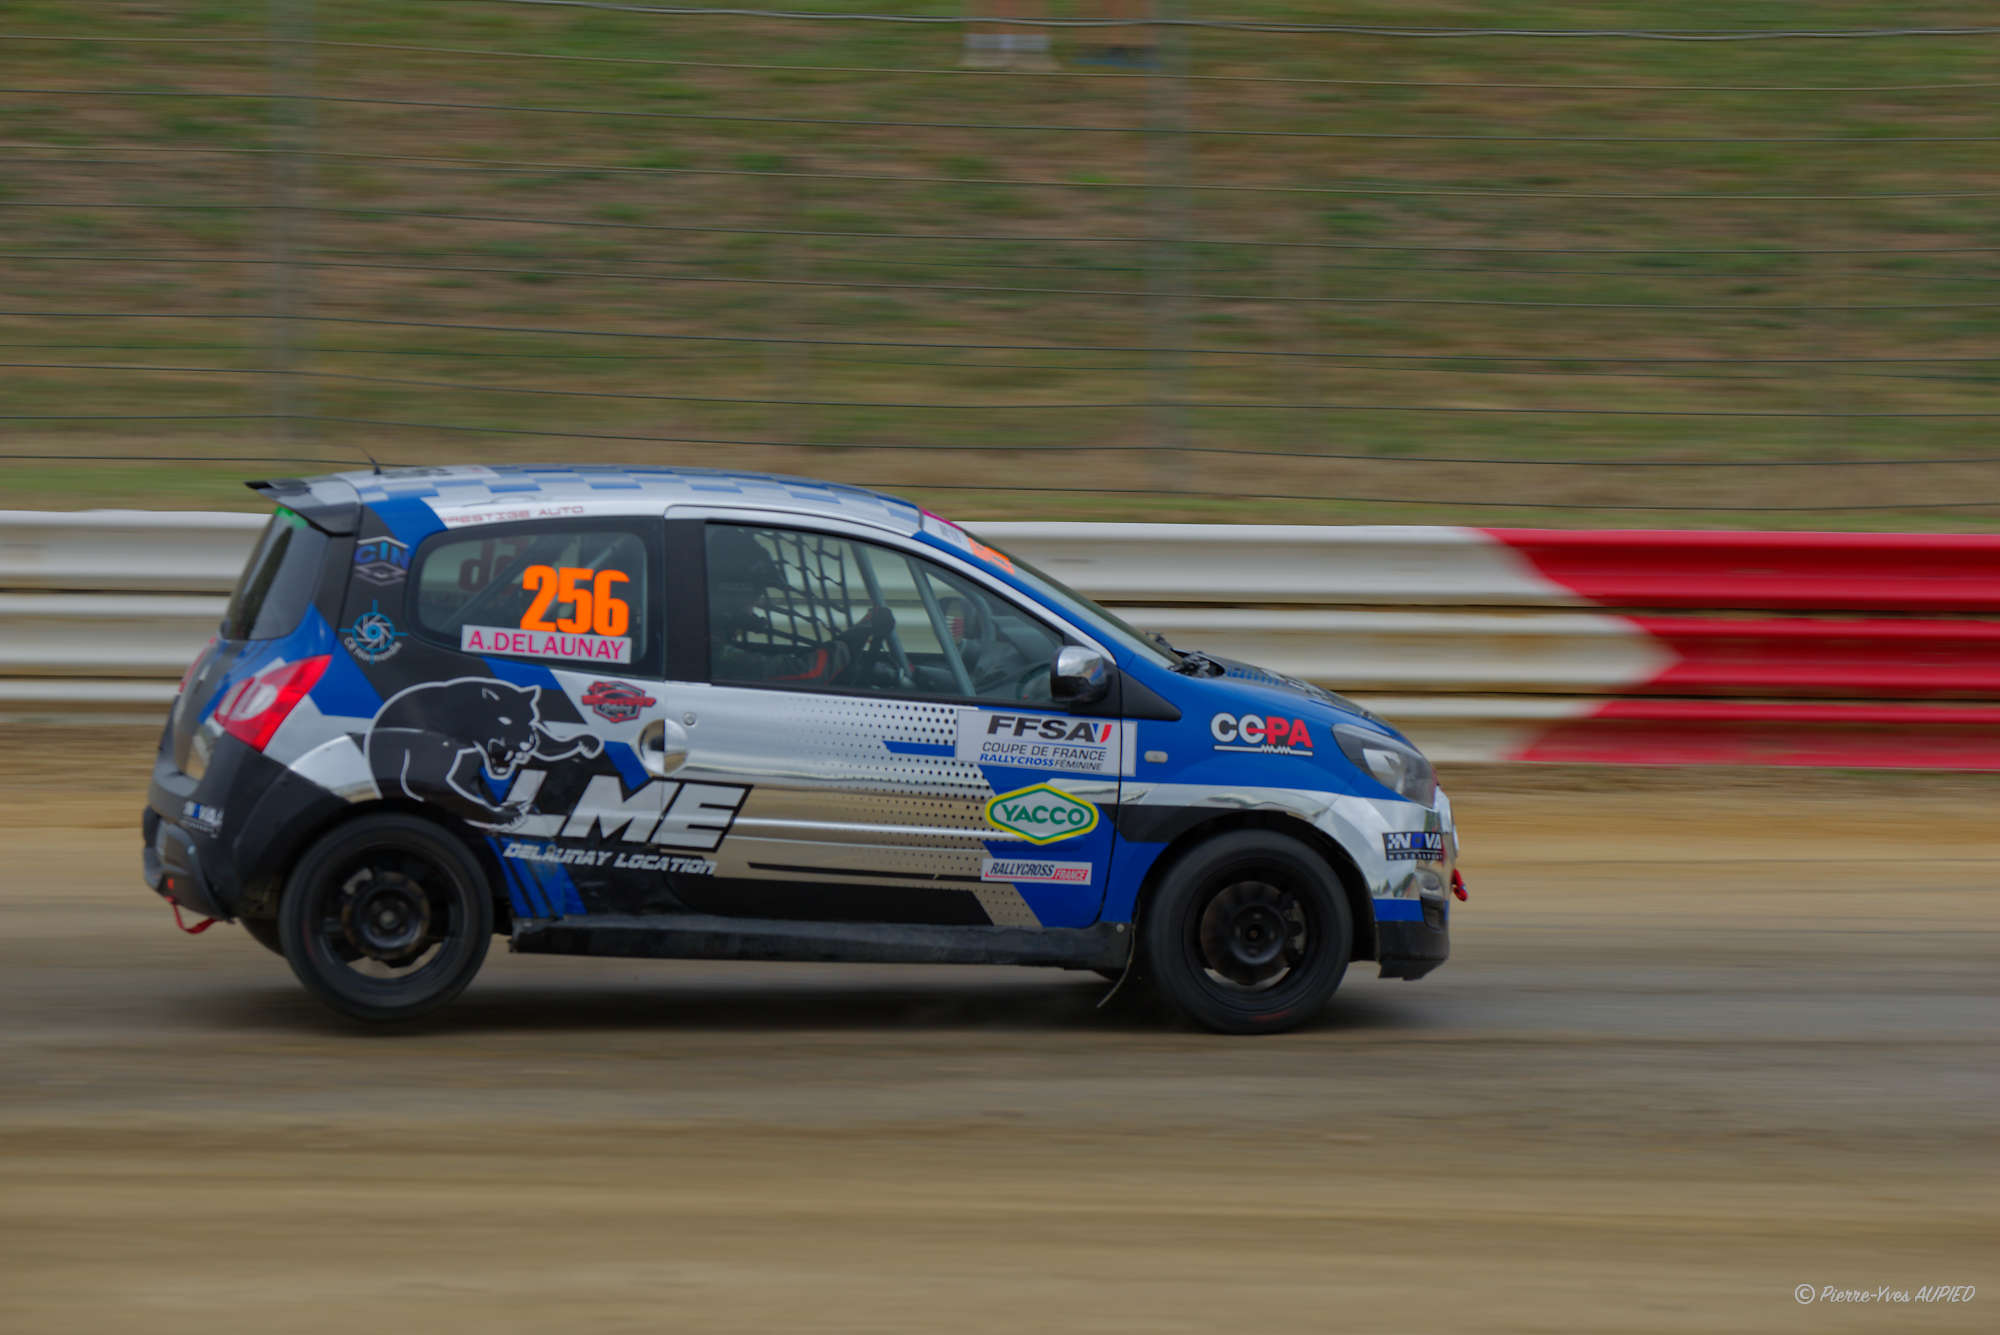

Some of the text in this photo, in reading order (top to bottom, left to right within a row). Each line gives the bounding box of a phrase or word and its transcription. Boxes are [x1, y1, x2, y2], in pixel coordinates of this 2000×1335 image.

[538, 505, 584, 516] AUTO
[520, 564, 631, 637] 256
[468, 629, 625, 660] A.DELAUNAY
[987, 715, 1096, 743] FFSA
[979, 753, 1054, 767] RALLYCROSS
[982, 742, 1107, 761] COUPE DE FRANCE
[498, 769, 748, 850] LME
[1001, 804, 1086, 826] YACCO
[503, 842, 718, 875] DELAUNAY LOCATION
[991, 862, 1055, 877] RALLYCROSS
